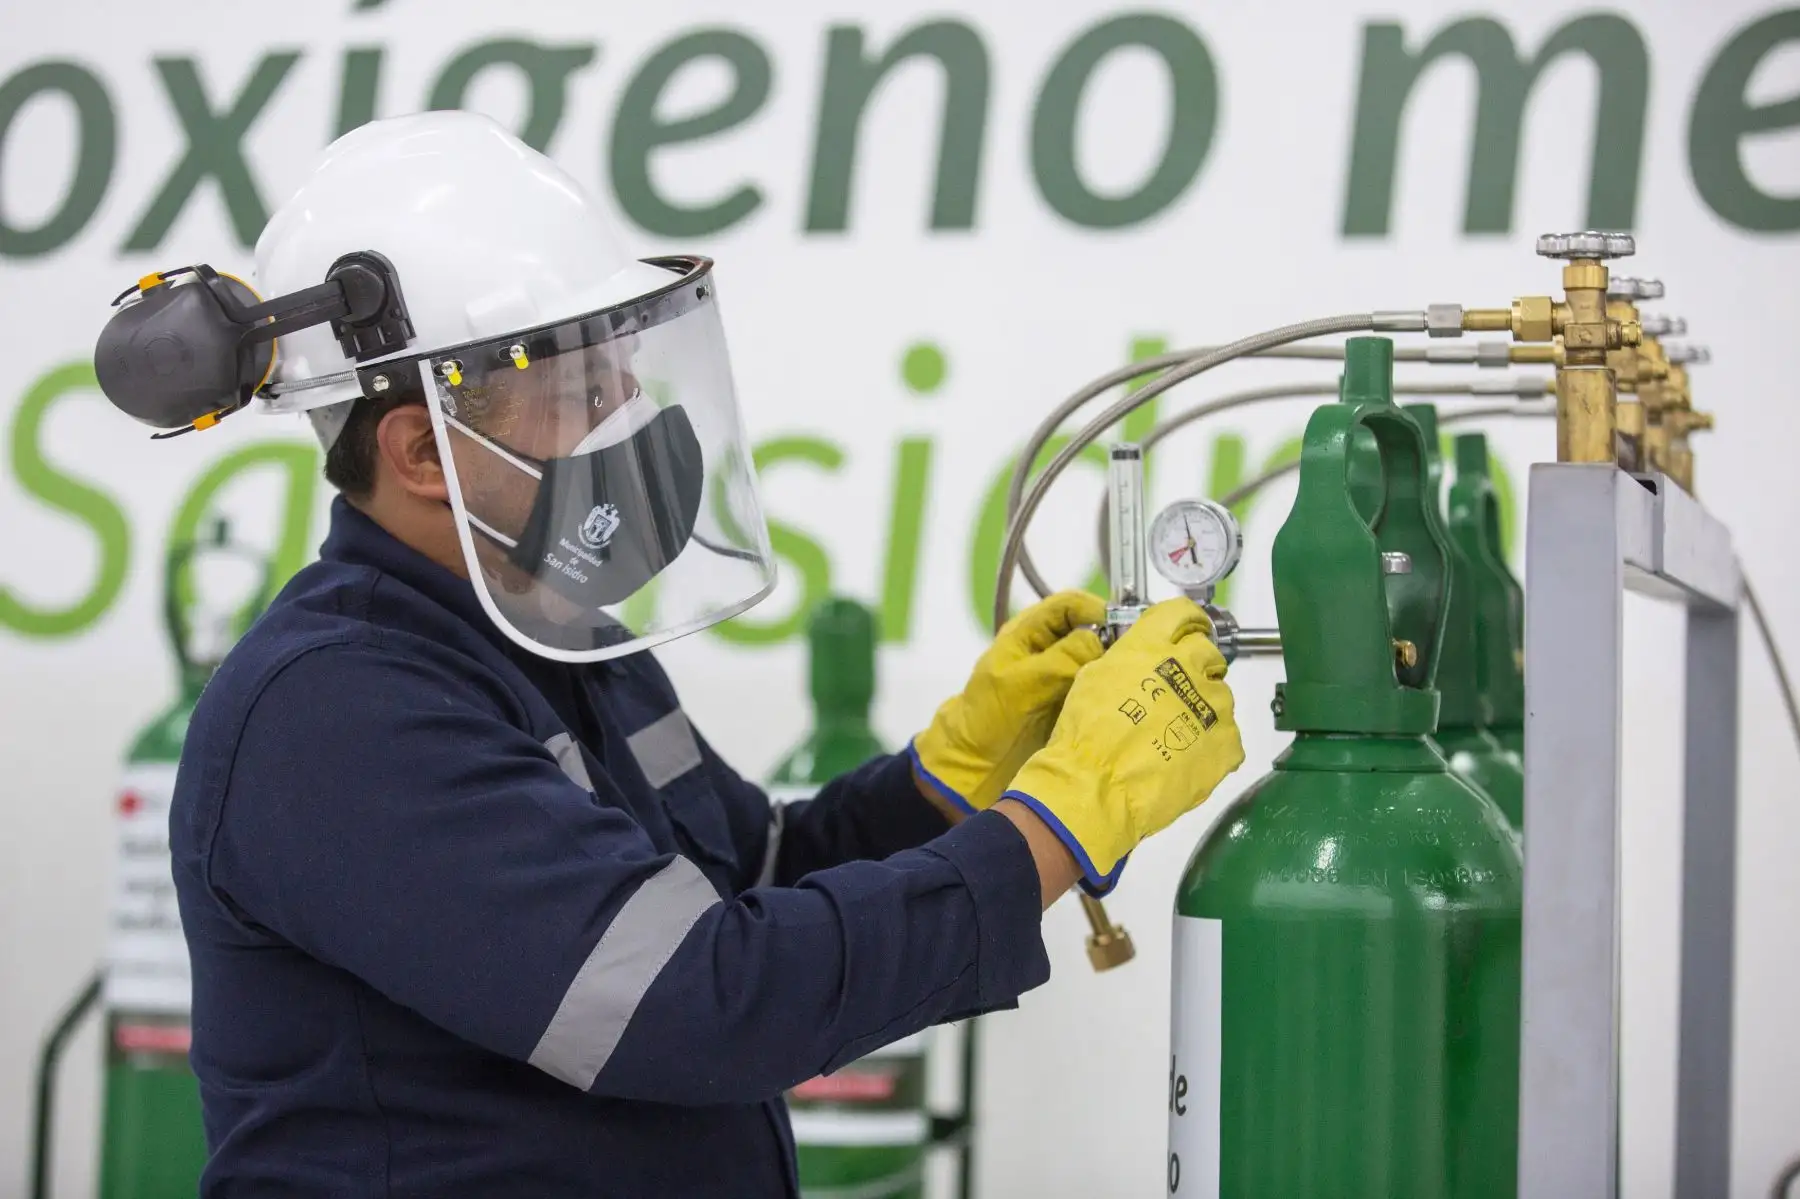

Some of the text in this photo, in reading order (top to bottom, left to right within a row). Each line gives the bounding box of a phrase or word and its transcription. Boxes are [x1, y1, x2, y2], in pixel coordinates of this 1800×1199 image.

[0, 357, 320, 645] Sa
[544, 553, 589, 583] San Isidro
[1167, 663, 1212, 718] TARWEX
